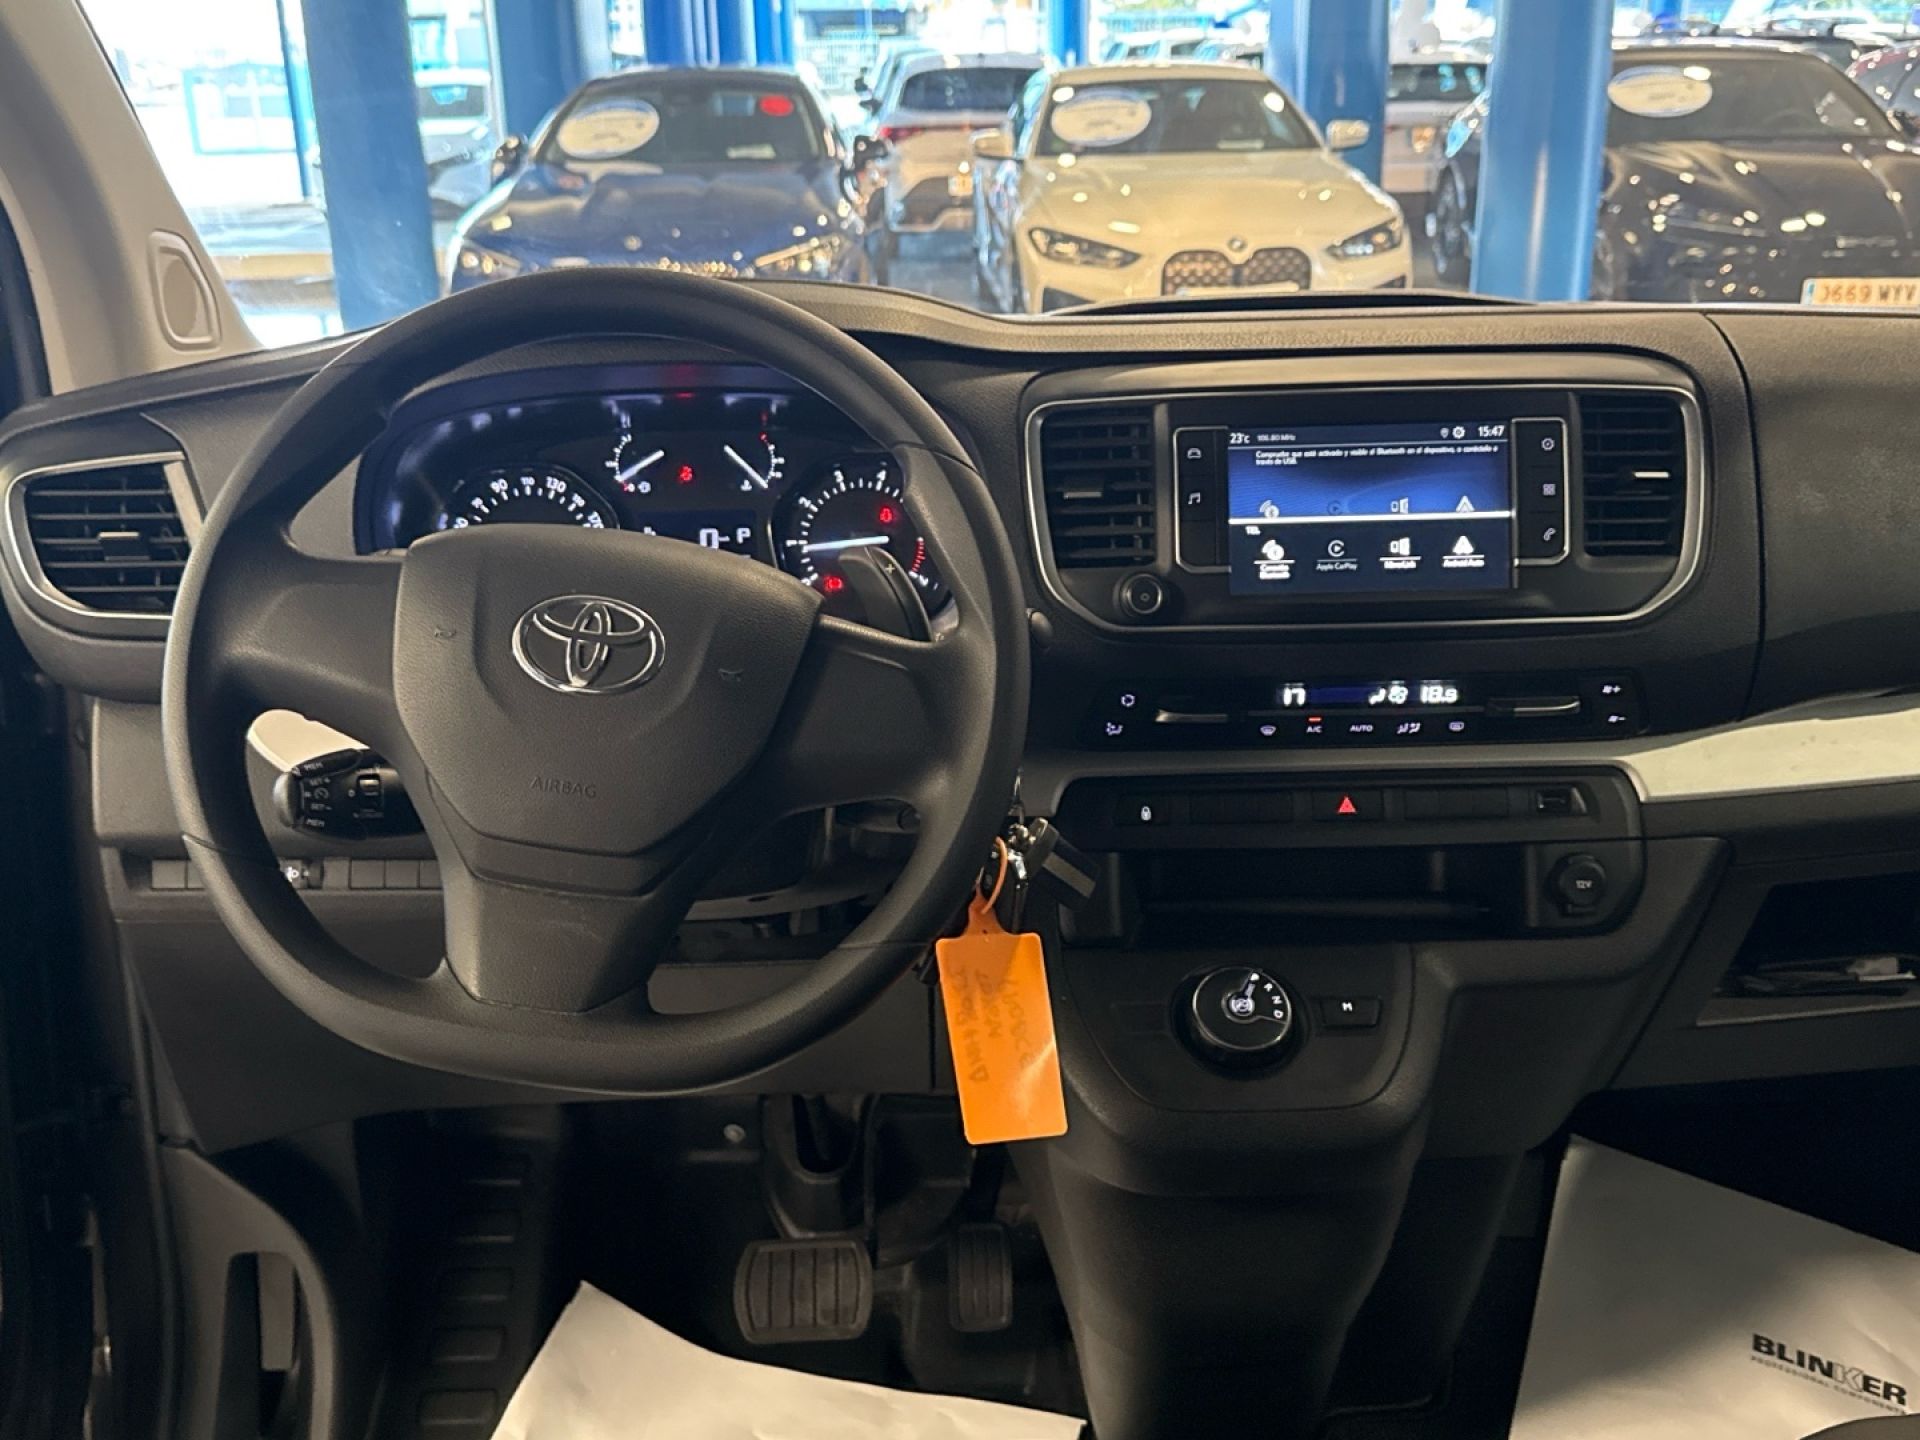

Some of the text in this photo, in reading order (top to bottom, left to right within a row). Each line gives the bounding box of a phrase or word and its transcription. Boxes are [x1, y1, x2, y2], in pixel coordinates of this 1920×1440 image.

[1478, 424, 1504, 437] 15:47
[520, 476, 536, 486] 110
[834, 470, 844, 482] 3
[876, 469, 887, 481] 4
[490, 478, 508, 494] 90
[546, 476, 567, 493] 130
[798, 496, 812, 508] 2
[736, 527, 751, 544] P
[1316, 562, 1359, 571] Apple CarPlay
[1306, 725, 1322, 733] A/C
[1349, 724, 1374, 733] AUTO
[528, 776, 597, 799] AIRBAG
[1752, 1333, 1908, 1406] BLINKER
